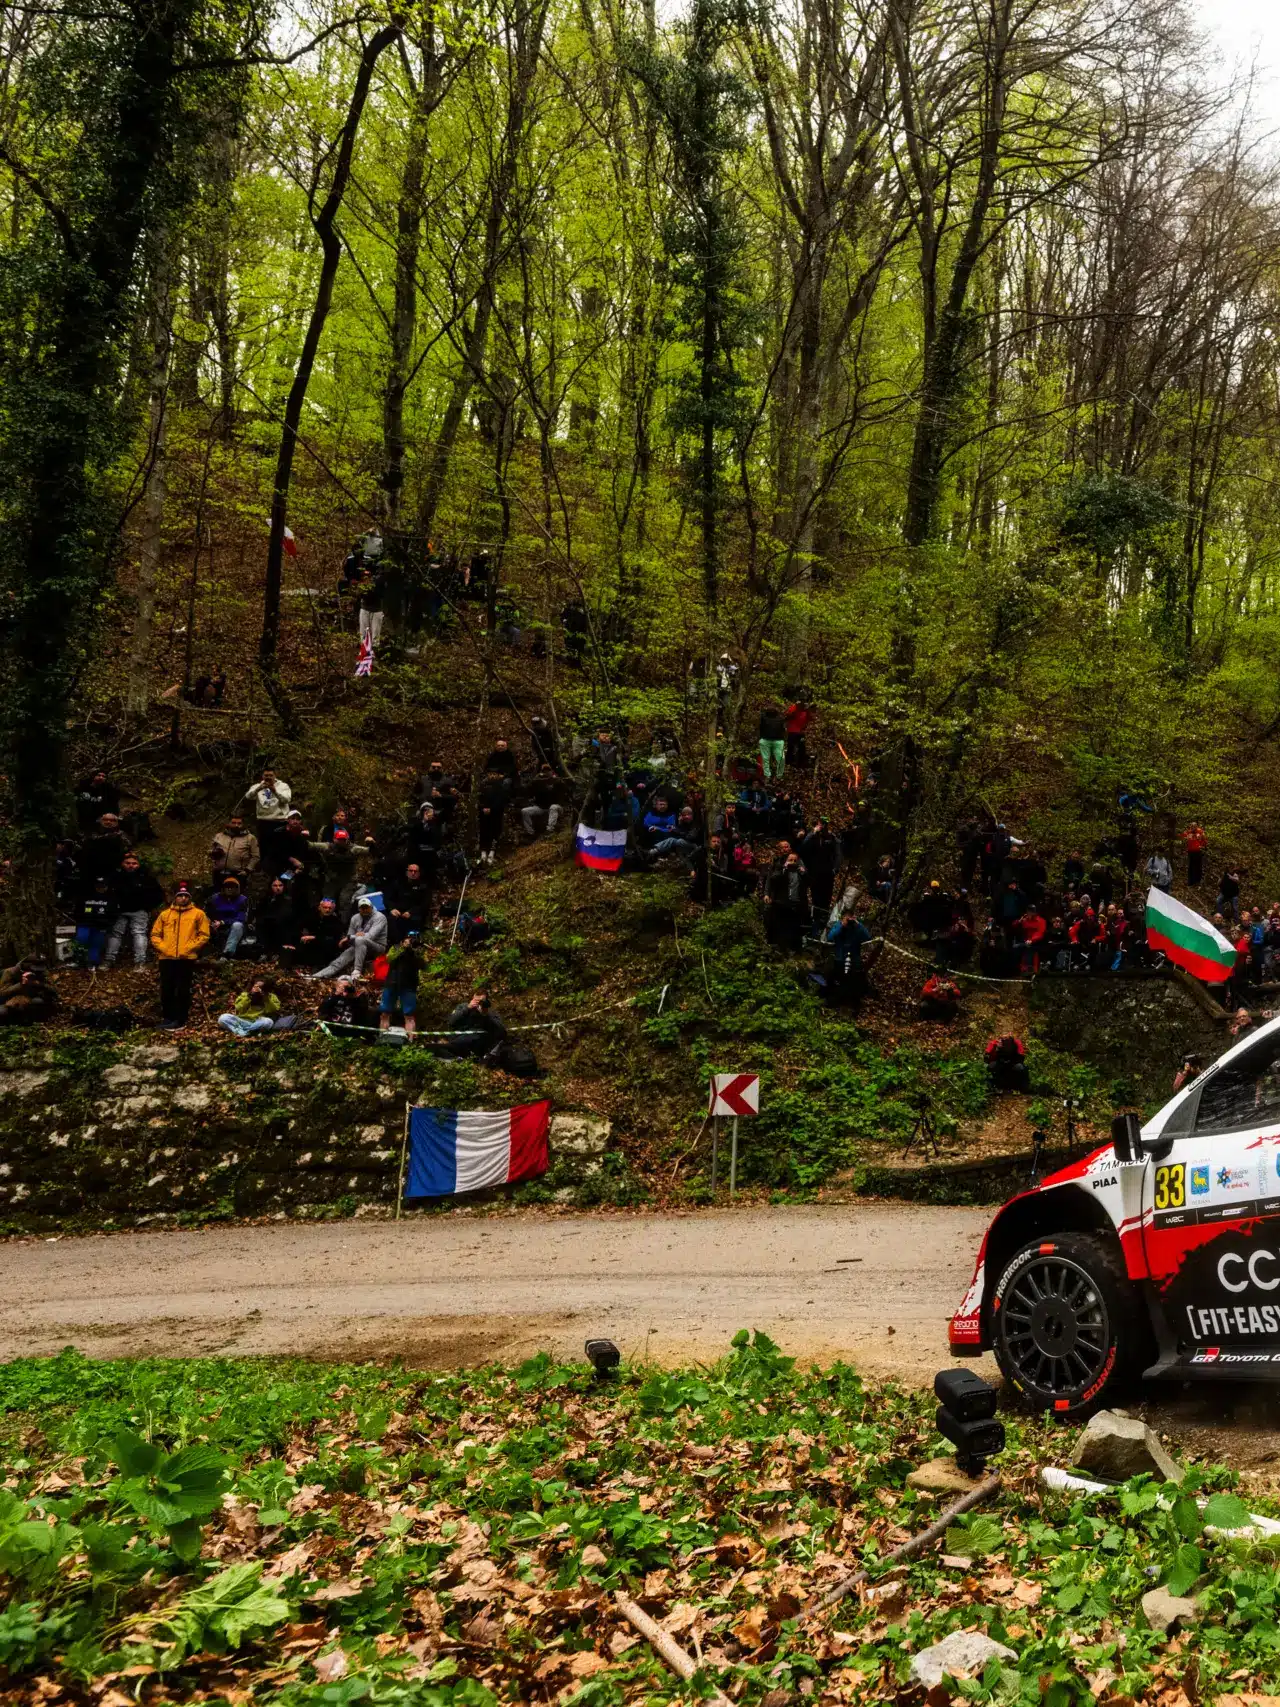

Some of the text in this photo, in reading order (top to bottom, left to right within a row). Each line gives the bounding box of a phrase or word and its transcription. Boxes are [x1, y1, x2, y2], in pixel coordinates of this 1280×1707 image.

[1092, 1176, 1118, 1189] PIAA
[1155, 1166, 1185, 1209] 33
[1165, 1215, 1184, 1224] WRC
[1219, 1354, 1269, 1362] TOYOTA
